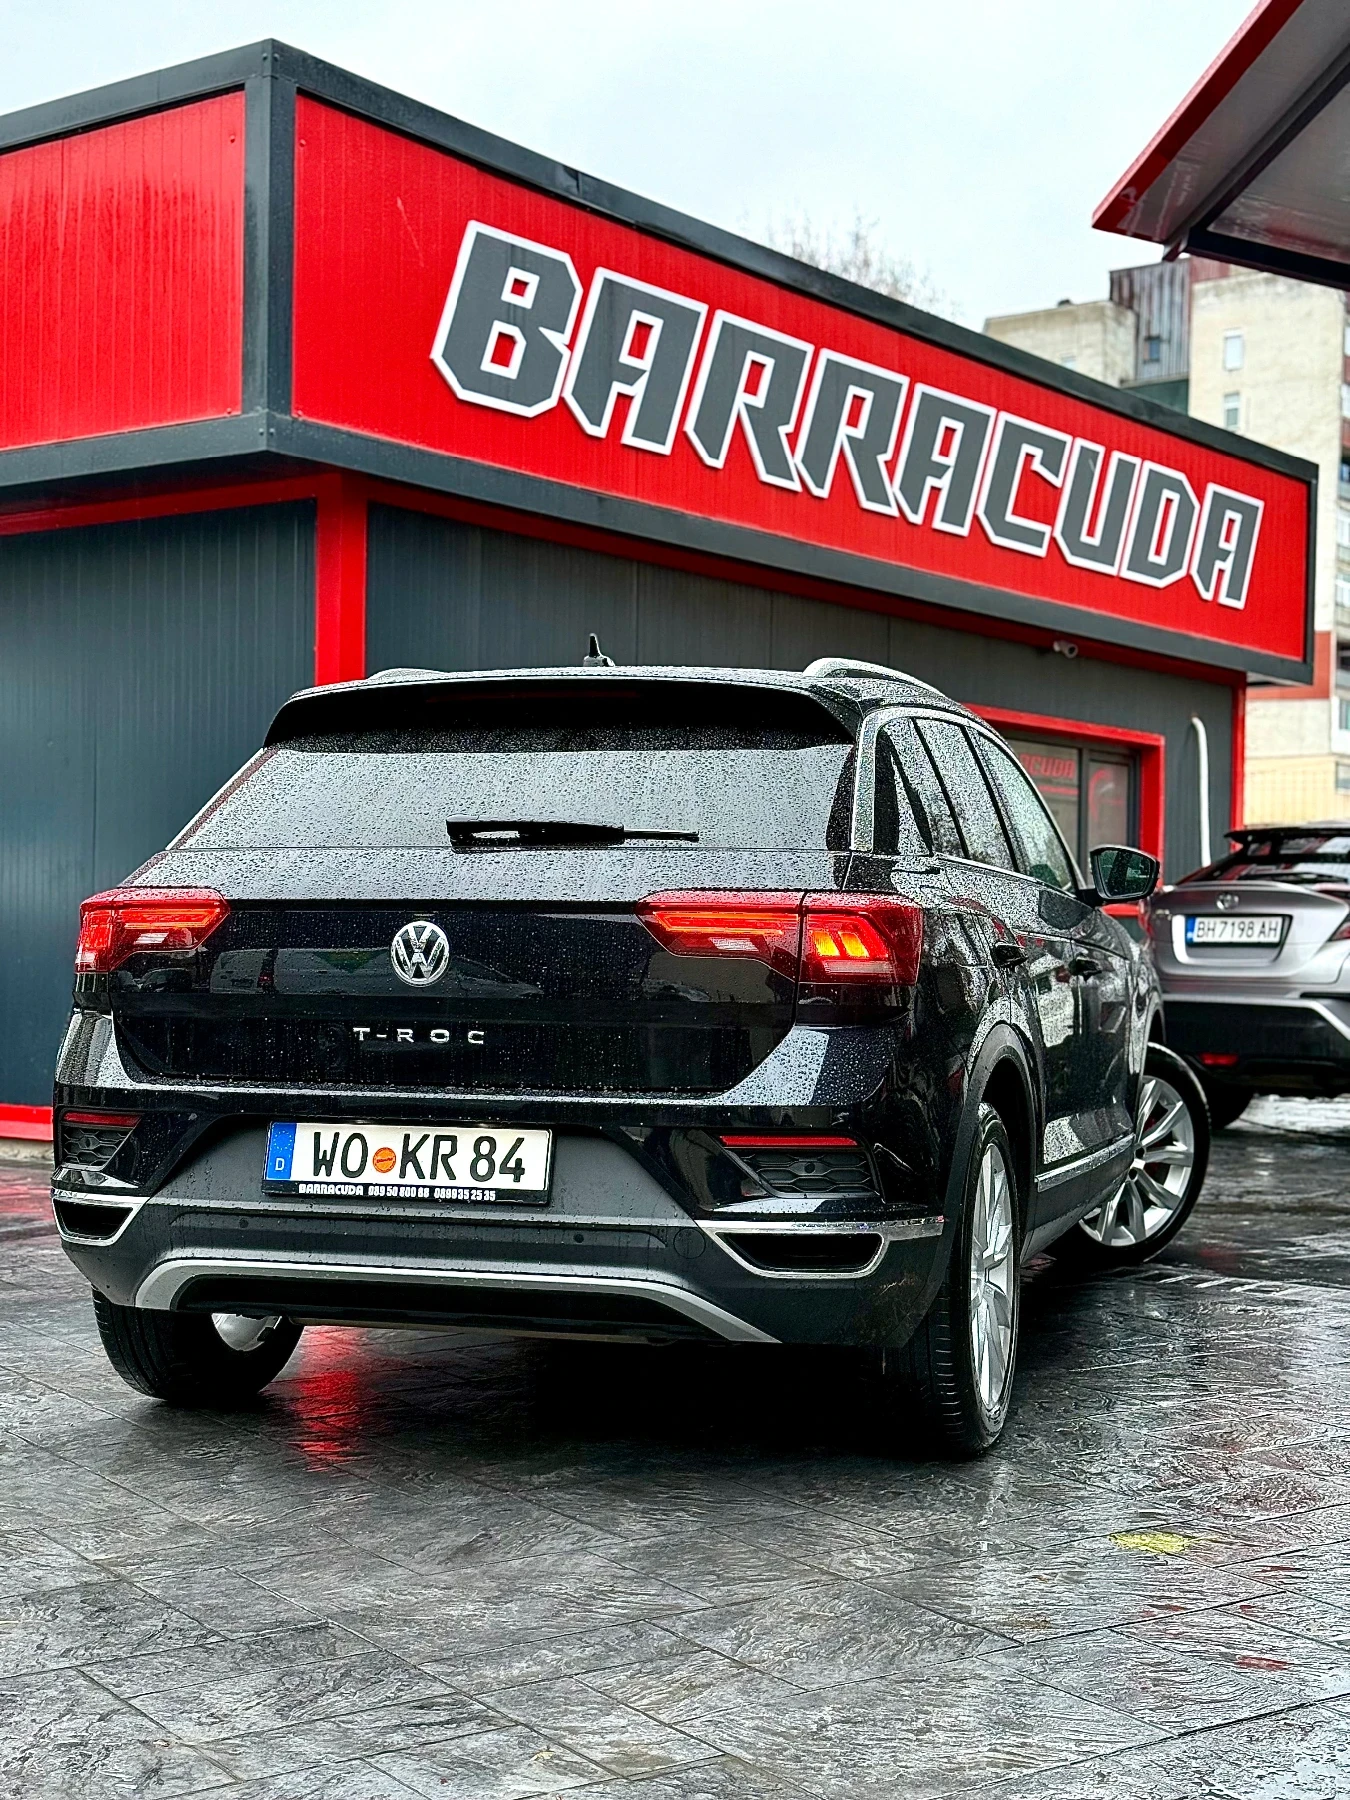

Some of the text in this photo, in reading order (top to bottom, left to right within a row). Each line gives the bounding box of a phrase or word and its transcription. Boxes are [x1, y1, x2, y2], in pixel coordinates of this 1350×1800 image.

[429, 220, 1265, 609] BARRACUDA
[1220, 920, 1255, 938] 7198
[1258, 920, 1279, 938] AH
[352, 1027, 485, 1045] T-ROC
[275, 1158, 285, 1171] D
[313, 1131, 526, 1182] WO KR 84
[298, 1183, 364, 1196] BARRACUDA
